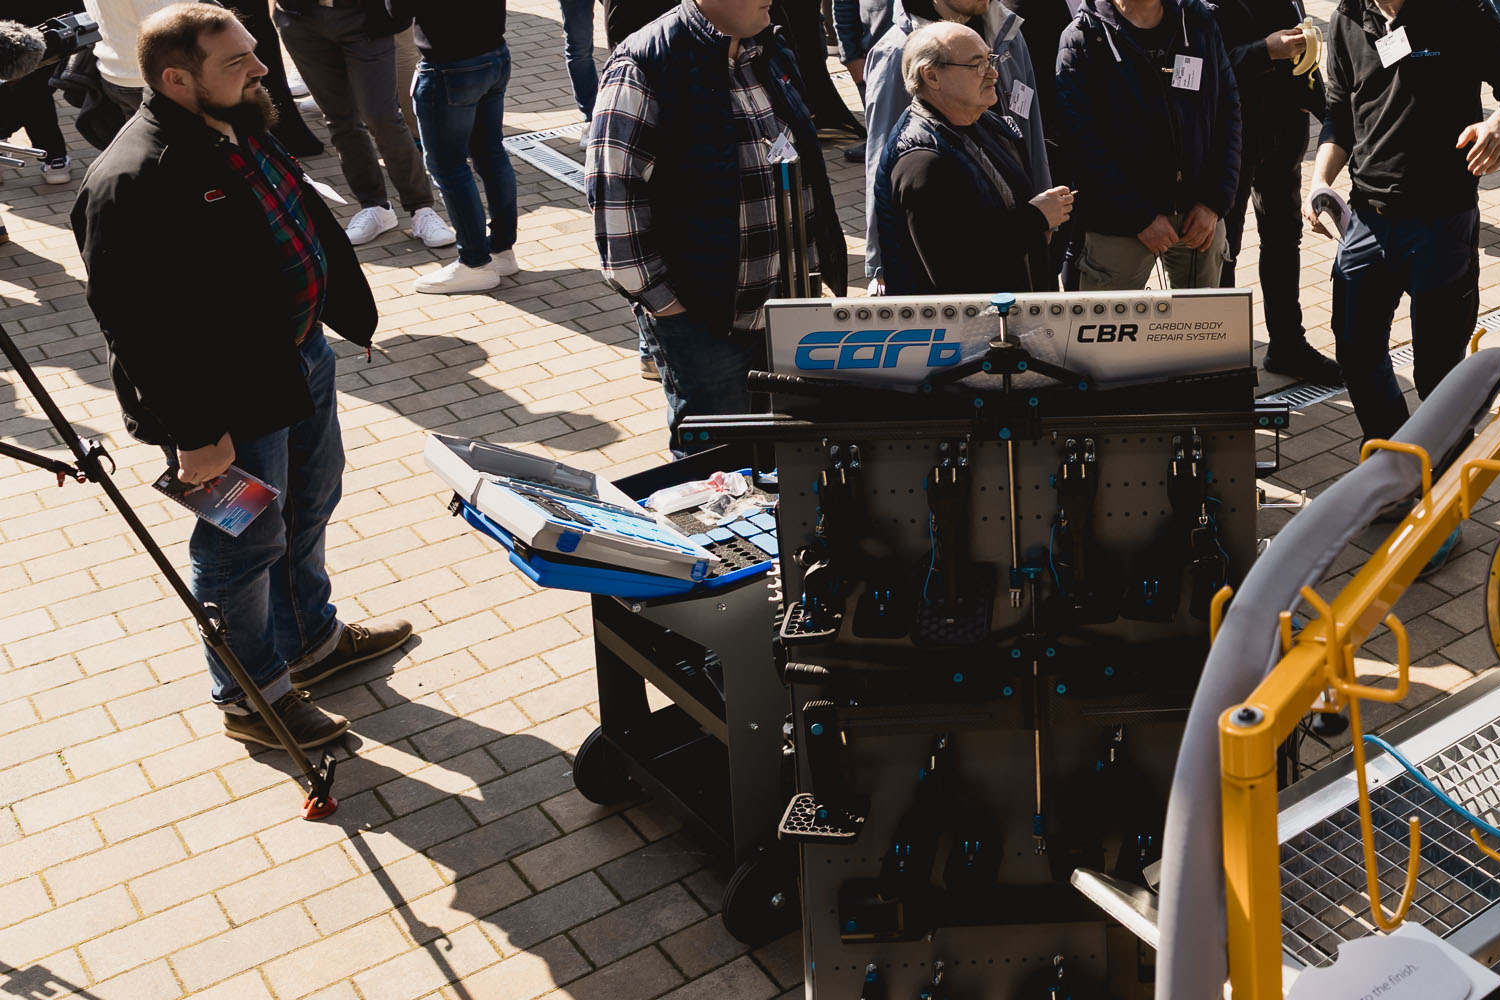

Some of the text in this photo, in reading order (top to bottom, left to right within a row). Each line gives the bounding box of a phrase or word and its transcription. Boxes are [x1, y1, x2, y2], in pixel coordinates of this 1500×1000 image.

[1076, 323, 1140, 343] CBR
[1148, 321, 1224, 331] CARBON BODY
[1146, 332, 1227, 342] REPAIR SYSTEM
[794, 328, 960, 371] carb
[1372, 981, 1392, 998] the
